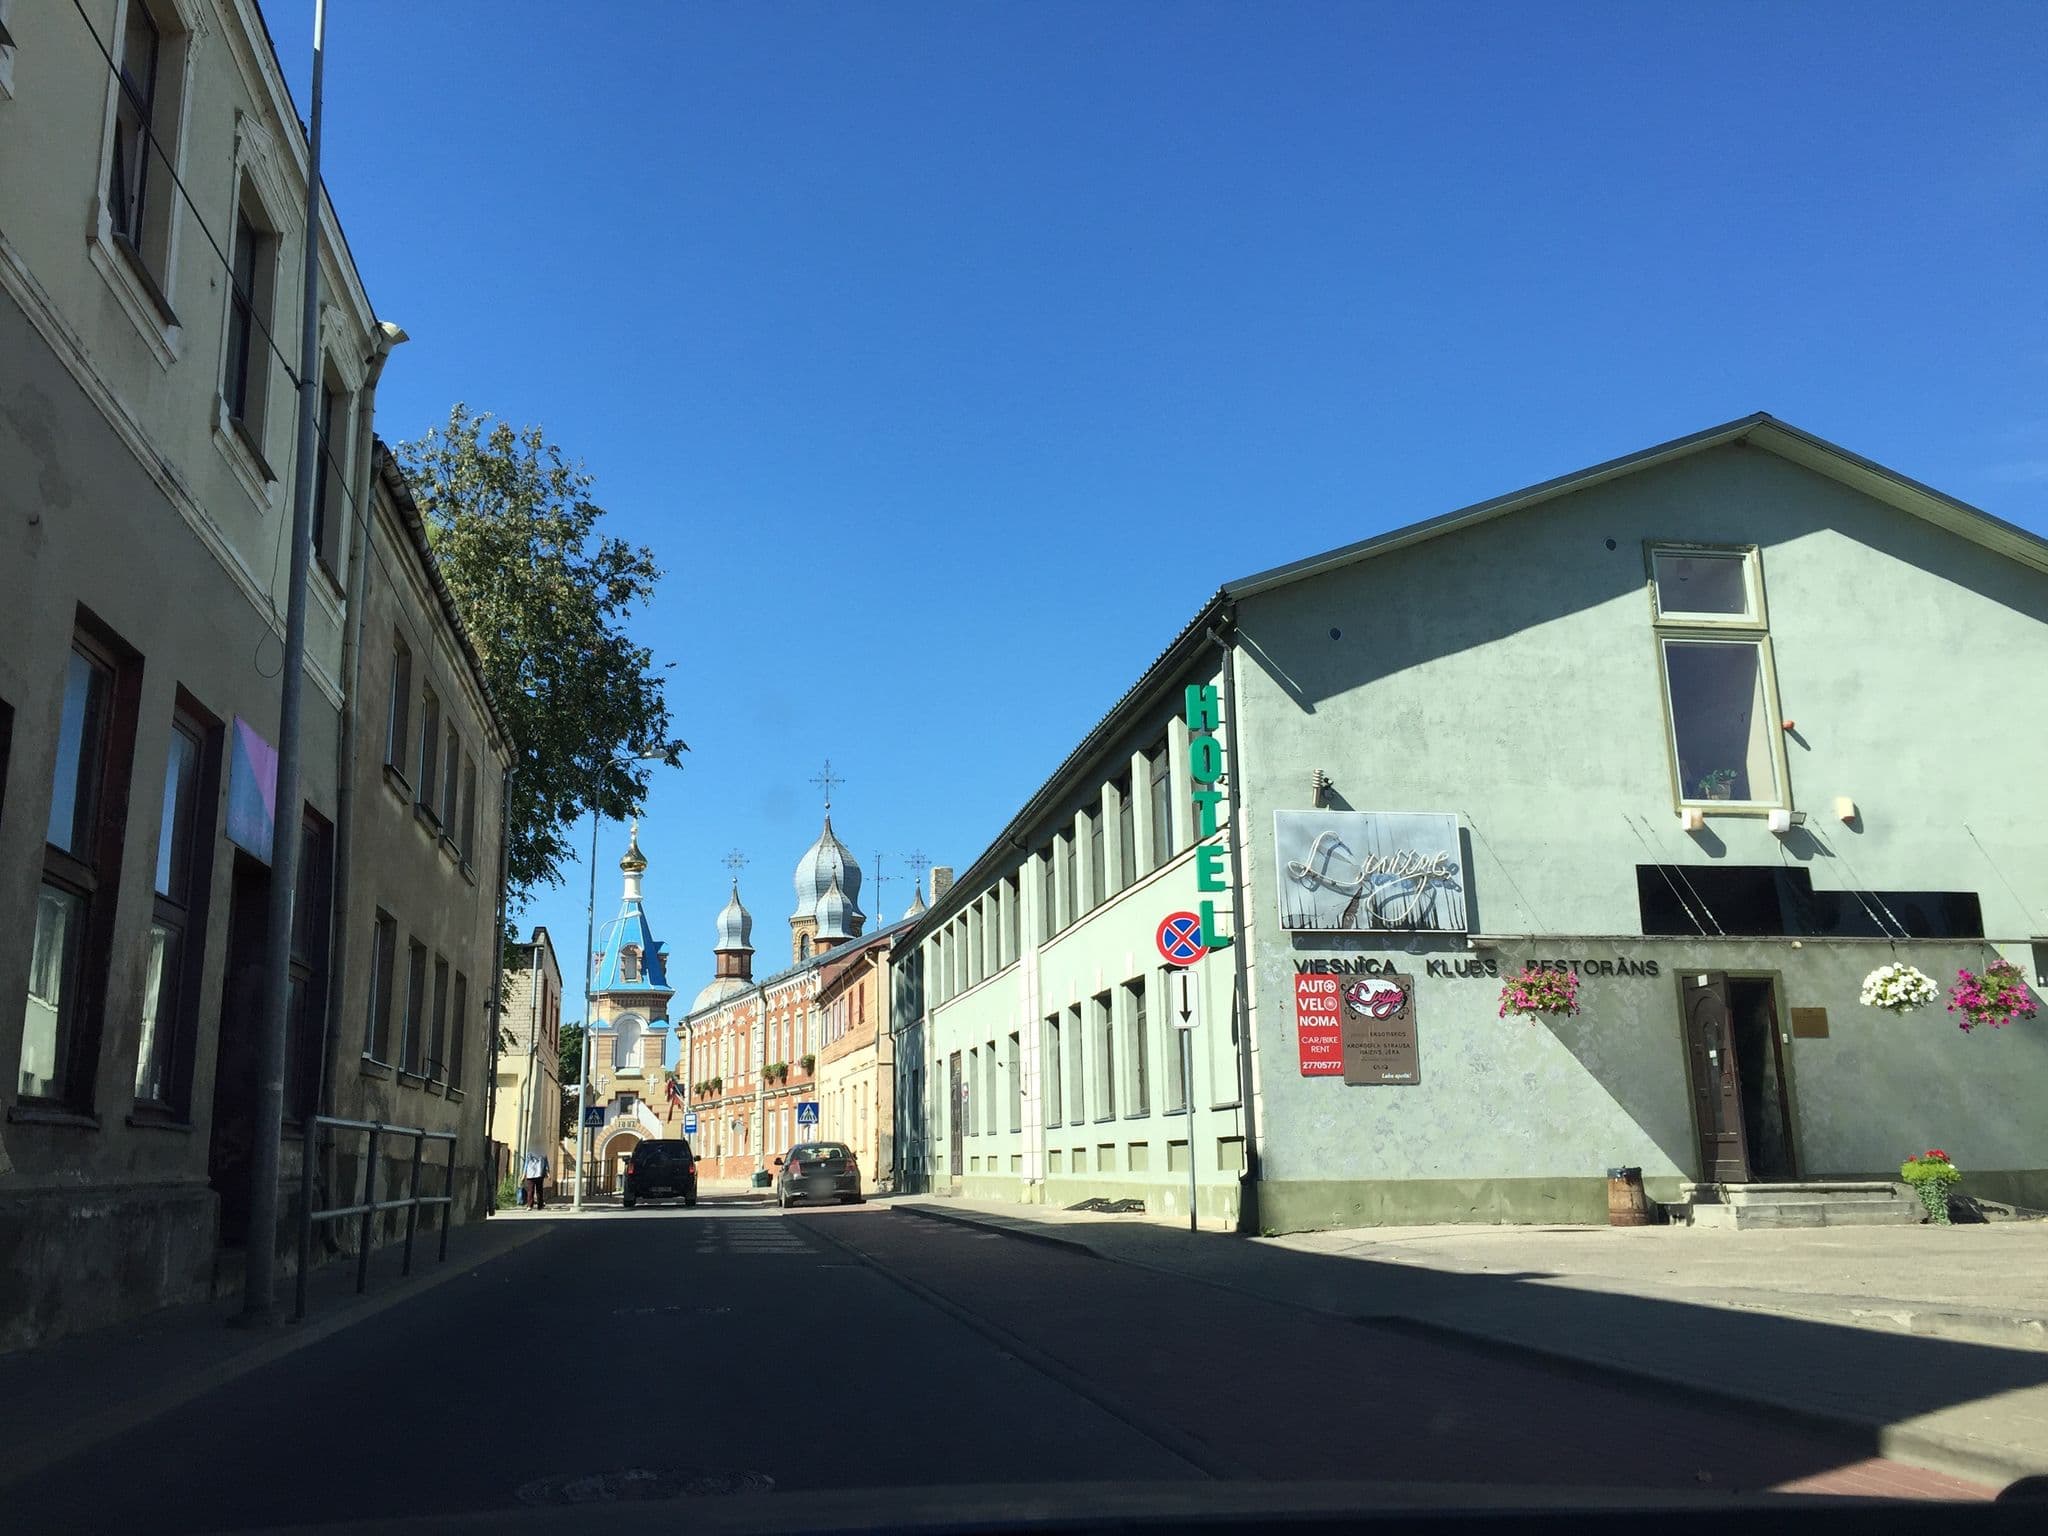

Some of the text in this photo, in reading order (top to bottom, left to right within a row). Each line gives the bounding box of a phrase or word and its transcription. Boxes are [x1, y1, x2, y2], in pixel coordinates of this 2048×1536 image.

[1185, 684, 1229, 946] HOTEL
[1426, 959, 1498, 978] KLUBS
[1298, 980, 1336, 993] AUTO
[1299, 996, 1337, 1011] VELO
[1300, 1016, 1338, 1027] NOMA
[1301, 1036, 1339, 1044] CAR/BIKE
[1310, 1045, 1330, 1053] RENT
[1302, 1061, 1341, 1069] 27705777
